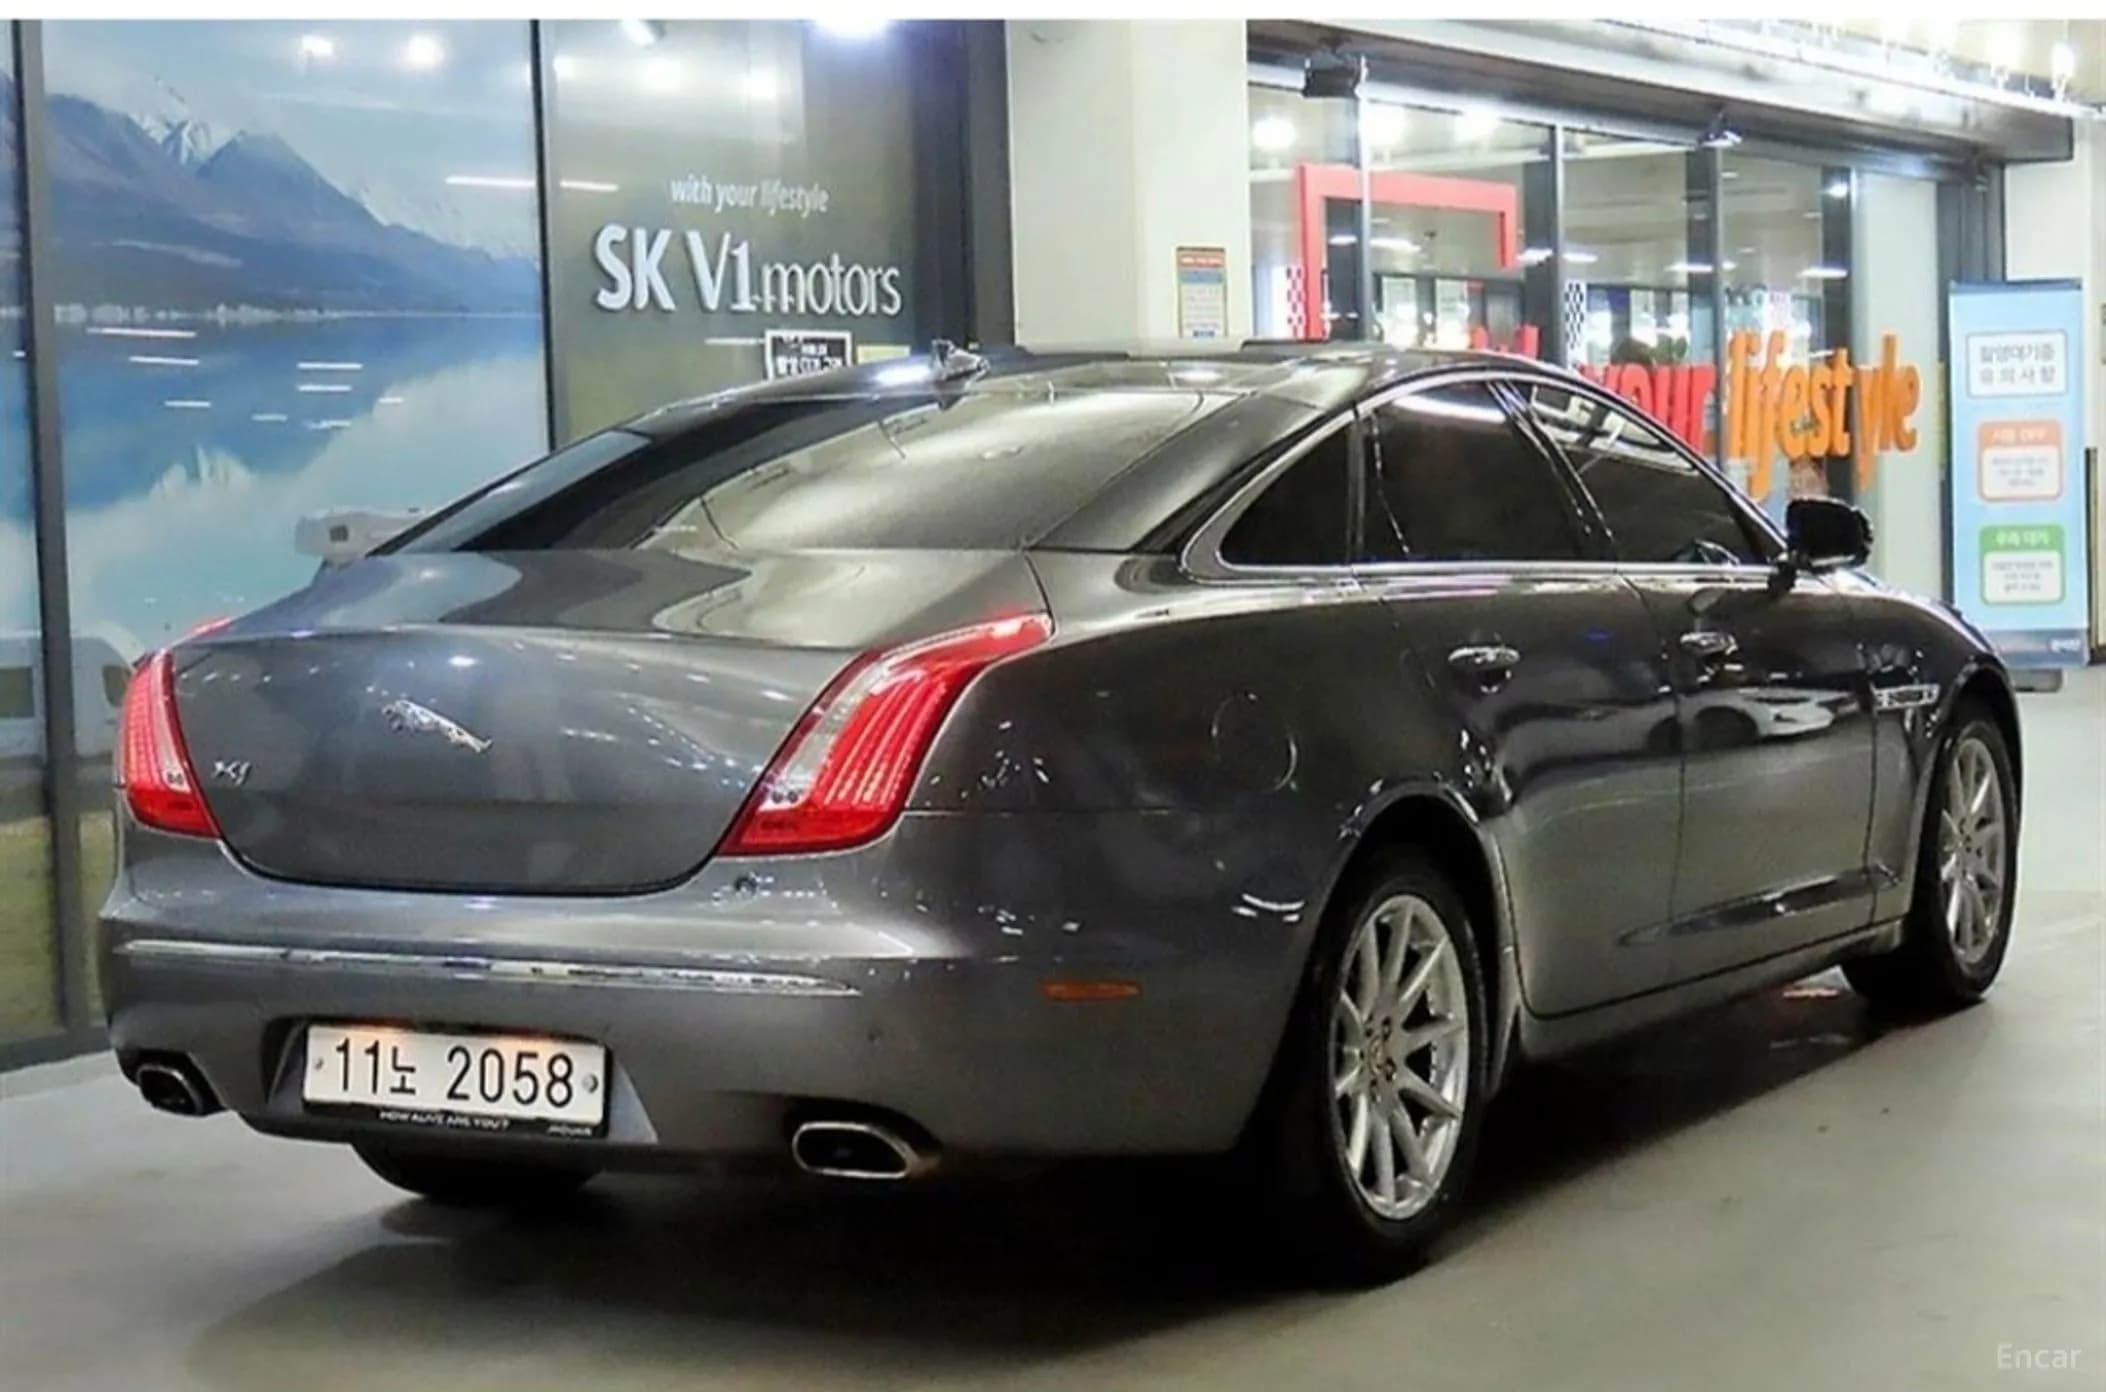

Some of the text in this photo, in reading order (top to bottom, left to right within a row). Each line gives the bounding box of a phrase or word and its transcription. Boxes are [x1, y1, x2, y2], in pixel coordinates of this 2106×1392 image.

[671, 174, 829, 217] with your lifestyle
[595, 223, 676, 312] SK
[1728, 328, 1921, 498] lifestyle
[336, 1037, 573, 1108] 11노 2058
